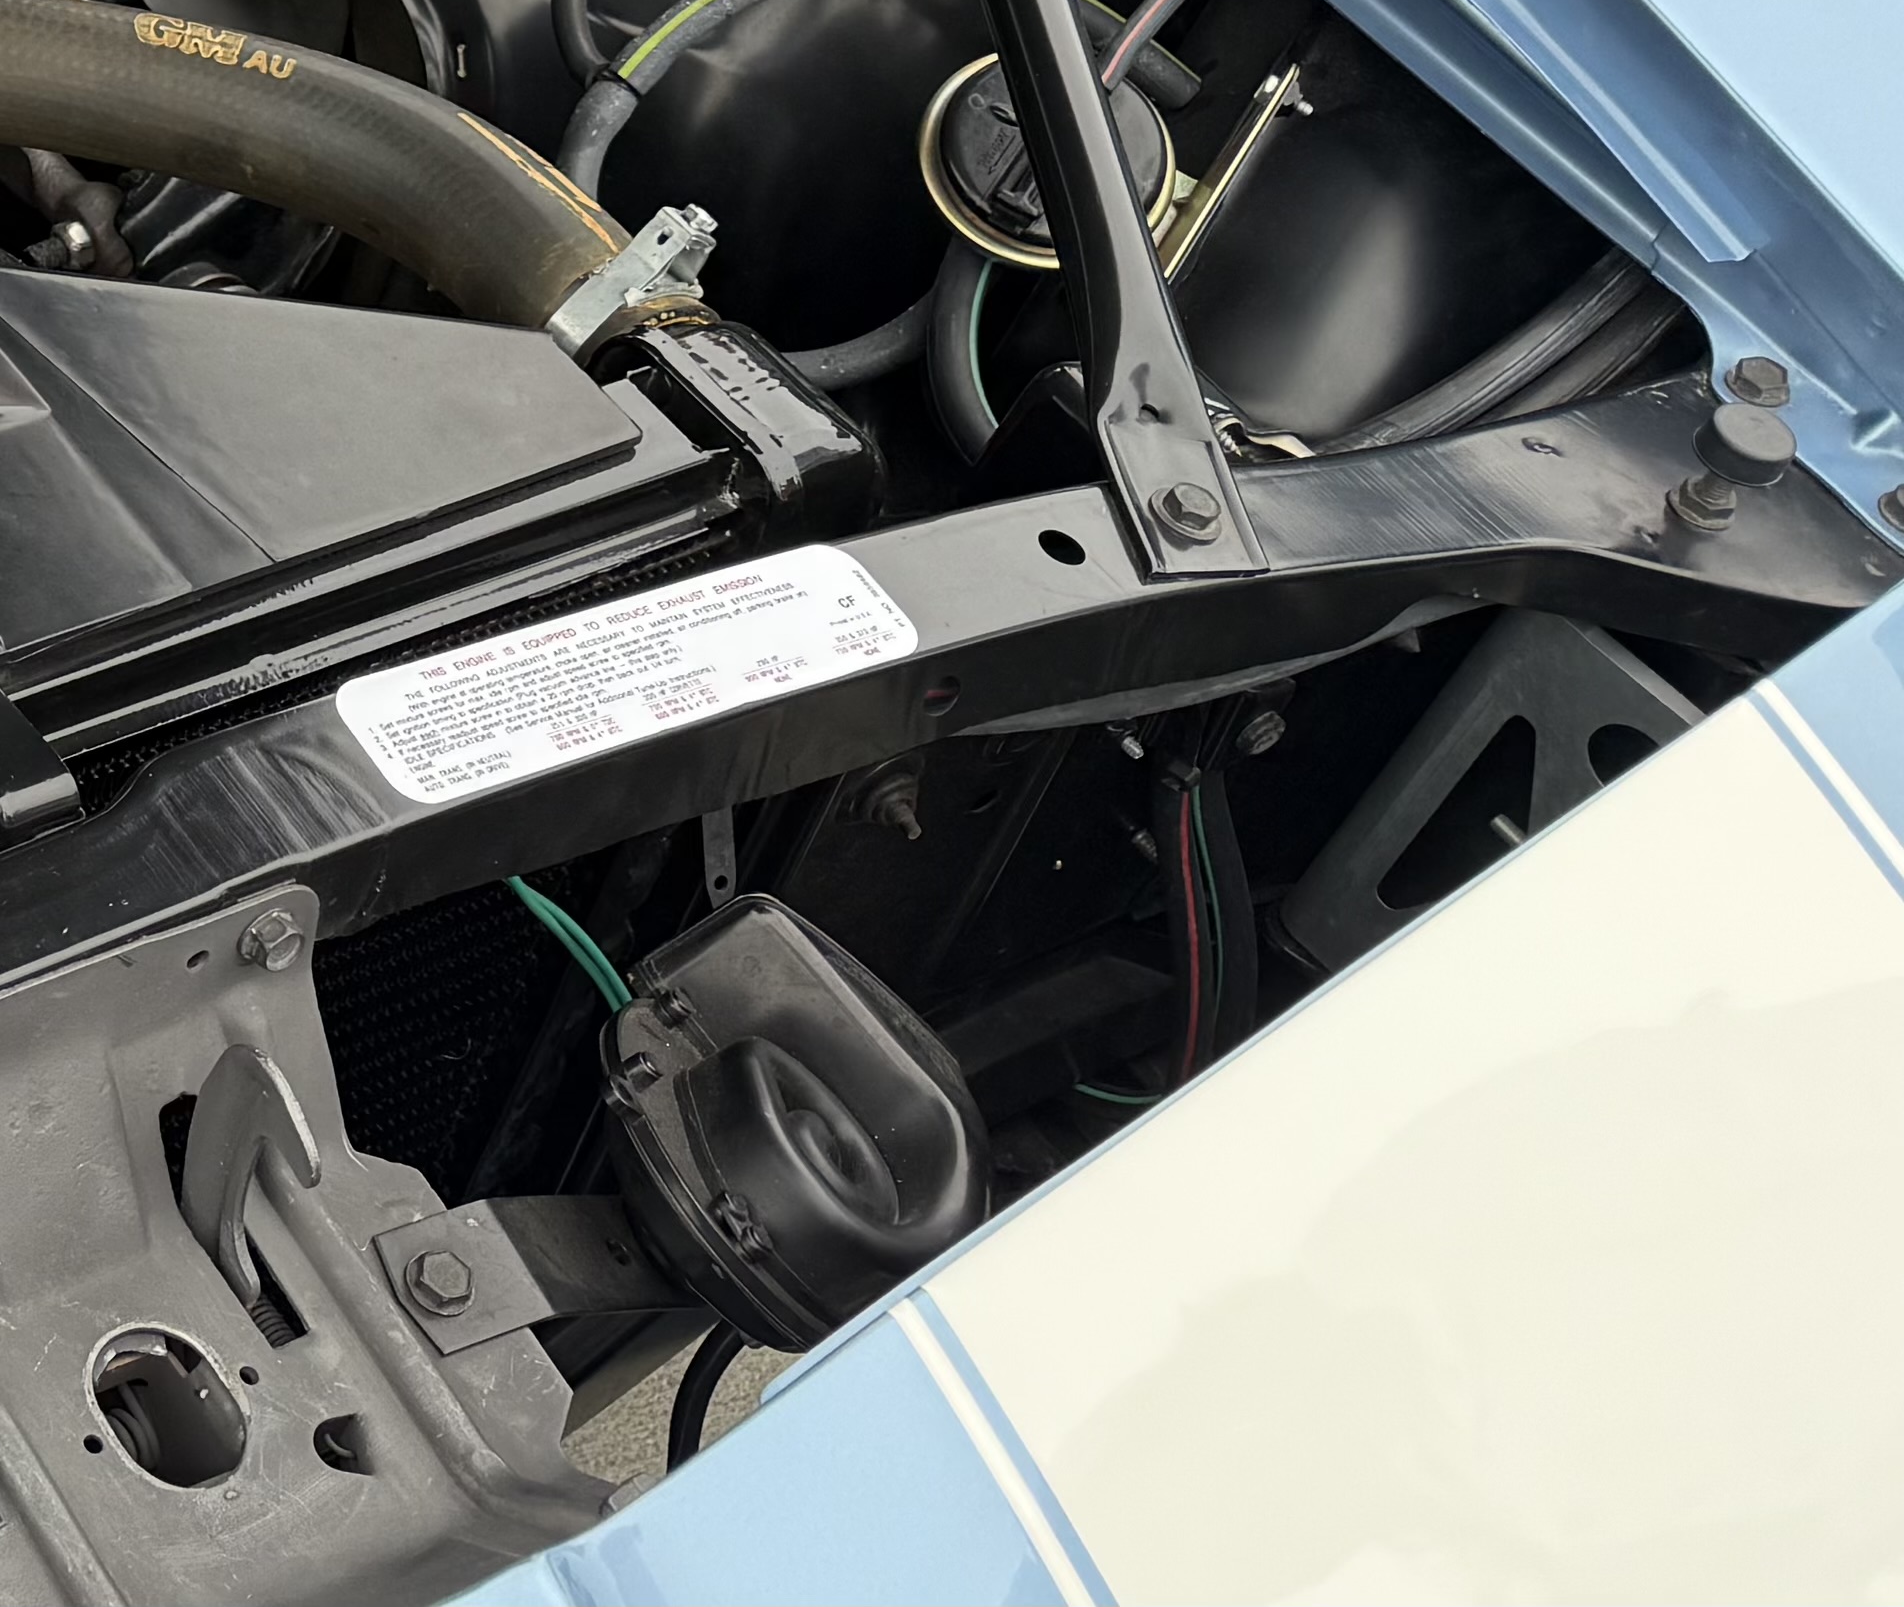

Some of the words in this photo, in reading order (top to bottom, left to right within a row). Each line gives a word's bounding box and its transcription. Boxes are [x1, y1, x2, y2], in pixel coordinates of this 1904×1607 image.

[134, 12, 247, 65] GM
[243, 49, 297, 79] AU
[418, 666, 447, 680] THIS
[452, 651, 496, 671] ENGINE
[501, 645, 516, 656] IS
[520, 627, 577, 650] EQUIPPED
[582, 620, 600, 631] TO
[605, 604, 653, 625] REDUCE
[656, 589, 705, 610] EXHAUST
[711, 574, 763, 594] EMISSION
[837, 594, 855, 608] CF
